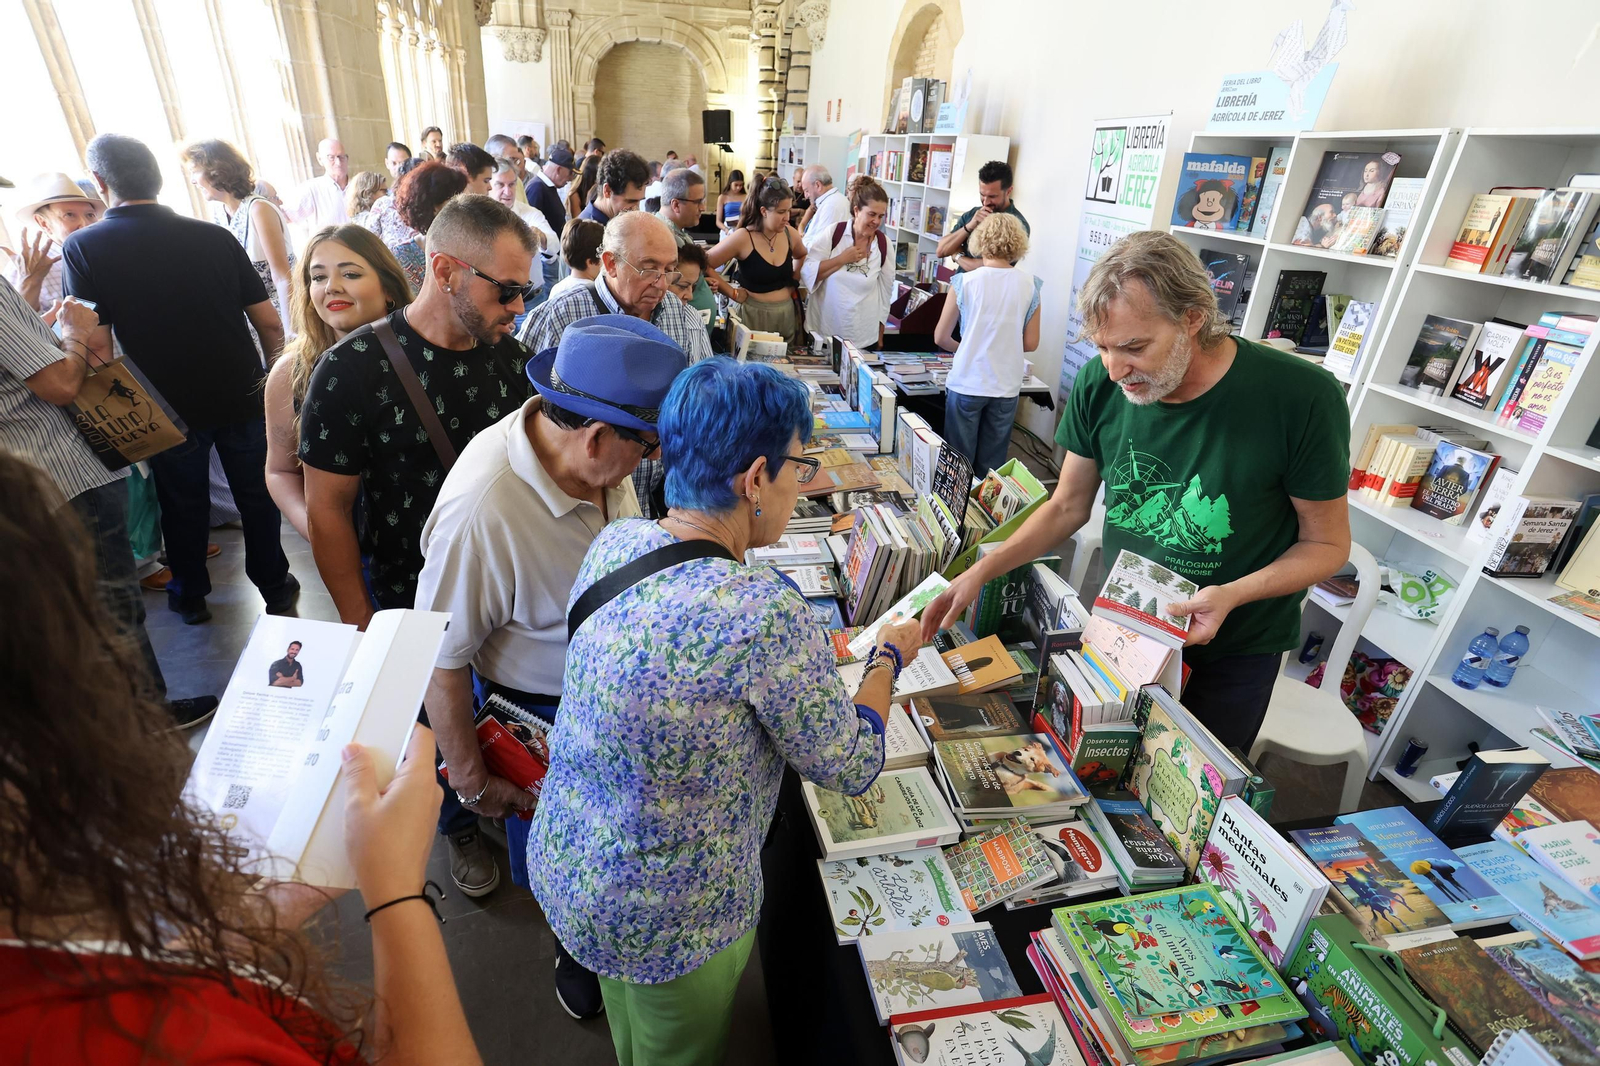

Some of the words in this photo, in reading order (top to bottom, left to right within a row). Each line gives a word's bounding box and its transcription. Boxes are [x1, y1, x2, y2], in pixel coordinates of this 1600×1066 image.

[1246, 77, 1262, 85] LIBRO
[1216, 92, 1257, 108] LIBRERÍA
[1211, 111, 1247, 122] AGRÍCOLA
[1248, 111, 1259, 121] DE
[1259, 110, 1285, 121] JEREZ
[1126, 120, 1165, 149] LIBRERÍA
[1128, 152, 1160, 173] AGRÍCOLA
[1186, 160, 1246, 175] mafalda
[1118, 174, 1157, 209] JEREZ
[1390, 190, 1421, 200] OLIVARE
[1341, 322, 1358, 332] CLAVES
[1349, 331, 1363, 341] CREAR
[1486, 330, 1513, 344] CARMEN
[1487, 338, 1504, 349] MOLA
[1542, 367, 1553, 379] Si
[1553, 371, 1563, 380] es
[1530, 380, 1565, 392] perfecto
[1543, 393, 1552, 402] es
[85, 404, 113, 425] LA
[1527, 402, 1548, 411] amor
[97, 410, 145, 439] LUNA
[112, 422, 161, 448] NUEVA
[1428, 483, 1461, 500] SIERRA
[1432, 475, 1464, 494] JAVIER
[1422, 494, 1434, 504] DEL
[1434, 497, 1457, 512] PRADO
[1430, 491, 1461, 508] MAESTRO
[1536, 526, 1554, 534] Jerez
[1489, 558, 1497, 569] DE
[1497, 537, 1509, 560] JEREZ
[1164, 555, 1222, 569] PRALOGNAN
[1178, 566, 1213, 577] VANOISE
[1001, 581, 1027, 598] CA
[1001, 598, 1026, 616] TU
[917, 660, 937, 686] PRIMERA
[1086, 738, 1117, 746] Observar
[1084, 746, 1130, 758] Insectos
[955, 742, 963, 753] del
[960, 753, 976, 781] cachorro
[964, 742, 991, 790] adiestramiento
[973, 741, 982, 756] Guía
[978, 755, 996, 780] práctica
[992, 779, 1001, 790] de
[1154, 770, 1188, 813] MEDICINALES
[1156, 761, 1191, 805] PLANTAS
[894, 776, 912, 808] CANGREJOS
[909, 806, 916, 814] DE
[913, 812, 924, 829] CÁDIZ
[905, 786, 914, 800] GUÍA
[911, 798, 918, 806] DE
[915, 804, 924, 816] LOS
[1151, 783, 1184, 827] CURATIVAS
[1433, 807, 1448, 826] SUEÑOS
[1444, 795, 1457, 812] LÚCIDOS
[1367, 822, 1385, 831] MITCH
[1385, 820, 1406, 829] ALBOM
[1222, 811, 1267, 865] Plantas
[1320, 835, 1352, 844] caballero
[1375, 831, 1402, 840] Martes
[1388, 840, 1404, 852] viejo
[1404, 836, 1436, 849] profesor
[1135, 846, 1163, 854] araña
[1312, 845, 1322, 853] de
[1323, 843, 1331, 852] la
[1330, 841, 1365, 851] armadura
[1541, 838, 1572, 851] MARIAN
[991, 841, 1014, 877] MARIPOSAS
[1330, 850, 1360, 858] oxidada
[1469, 861, 1484, 870] TE
[1484, 854, 1515, 868] QUIERO
[1549, 849, 1578, 860] ROJAS
[1560, 855, 1592, 869] ESTAPÉ
[1218, 825, 1289, 903] medicinales
[1480, 866, 1501, 878] PERO
[1504, 862, 1522, 872] NO
[1492, 870, 1542, 886] FUNCIONA
[871, 866, 905, 918] árboles
[891, 872, 913, 903] Los
[977, 931, 990, 950] AVES
[1174, 935, 1197, 961] Aves
[1155, 923, 1172, 939] del
[1166, 940, 1195, 977] mundo
[1341, 968, 1404, 1041] ANIMALES
[1361, 981, 1380, 1007] CONOCE,
[1379, 1004, 1403, 1029] EXPLORA
[1327, 964, 1337, 976] EN
[1336, 974, 1363, 1008] PELIGRO
[1363, 1006, 1373, 1019] DE
[1372, 1017, 1412, 1064] EXTINCIÓN
[945, 1037, 956, 1053] EN
[953, 1024, 967, 1050] QUE
[980, 1020, 989, 1035] EL
[987, 1036, 1005, 1064] PAÍS
